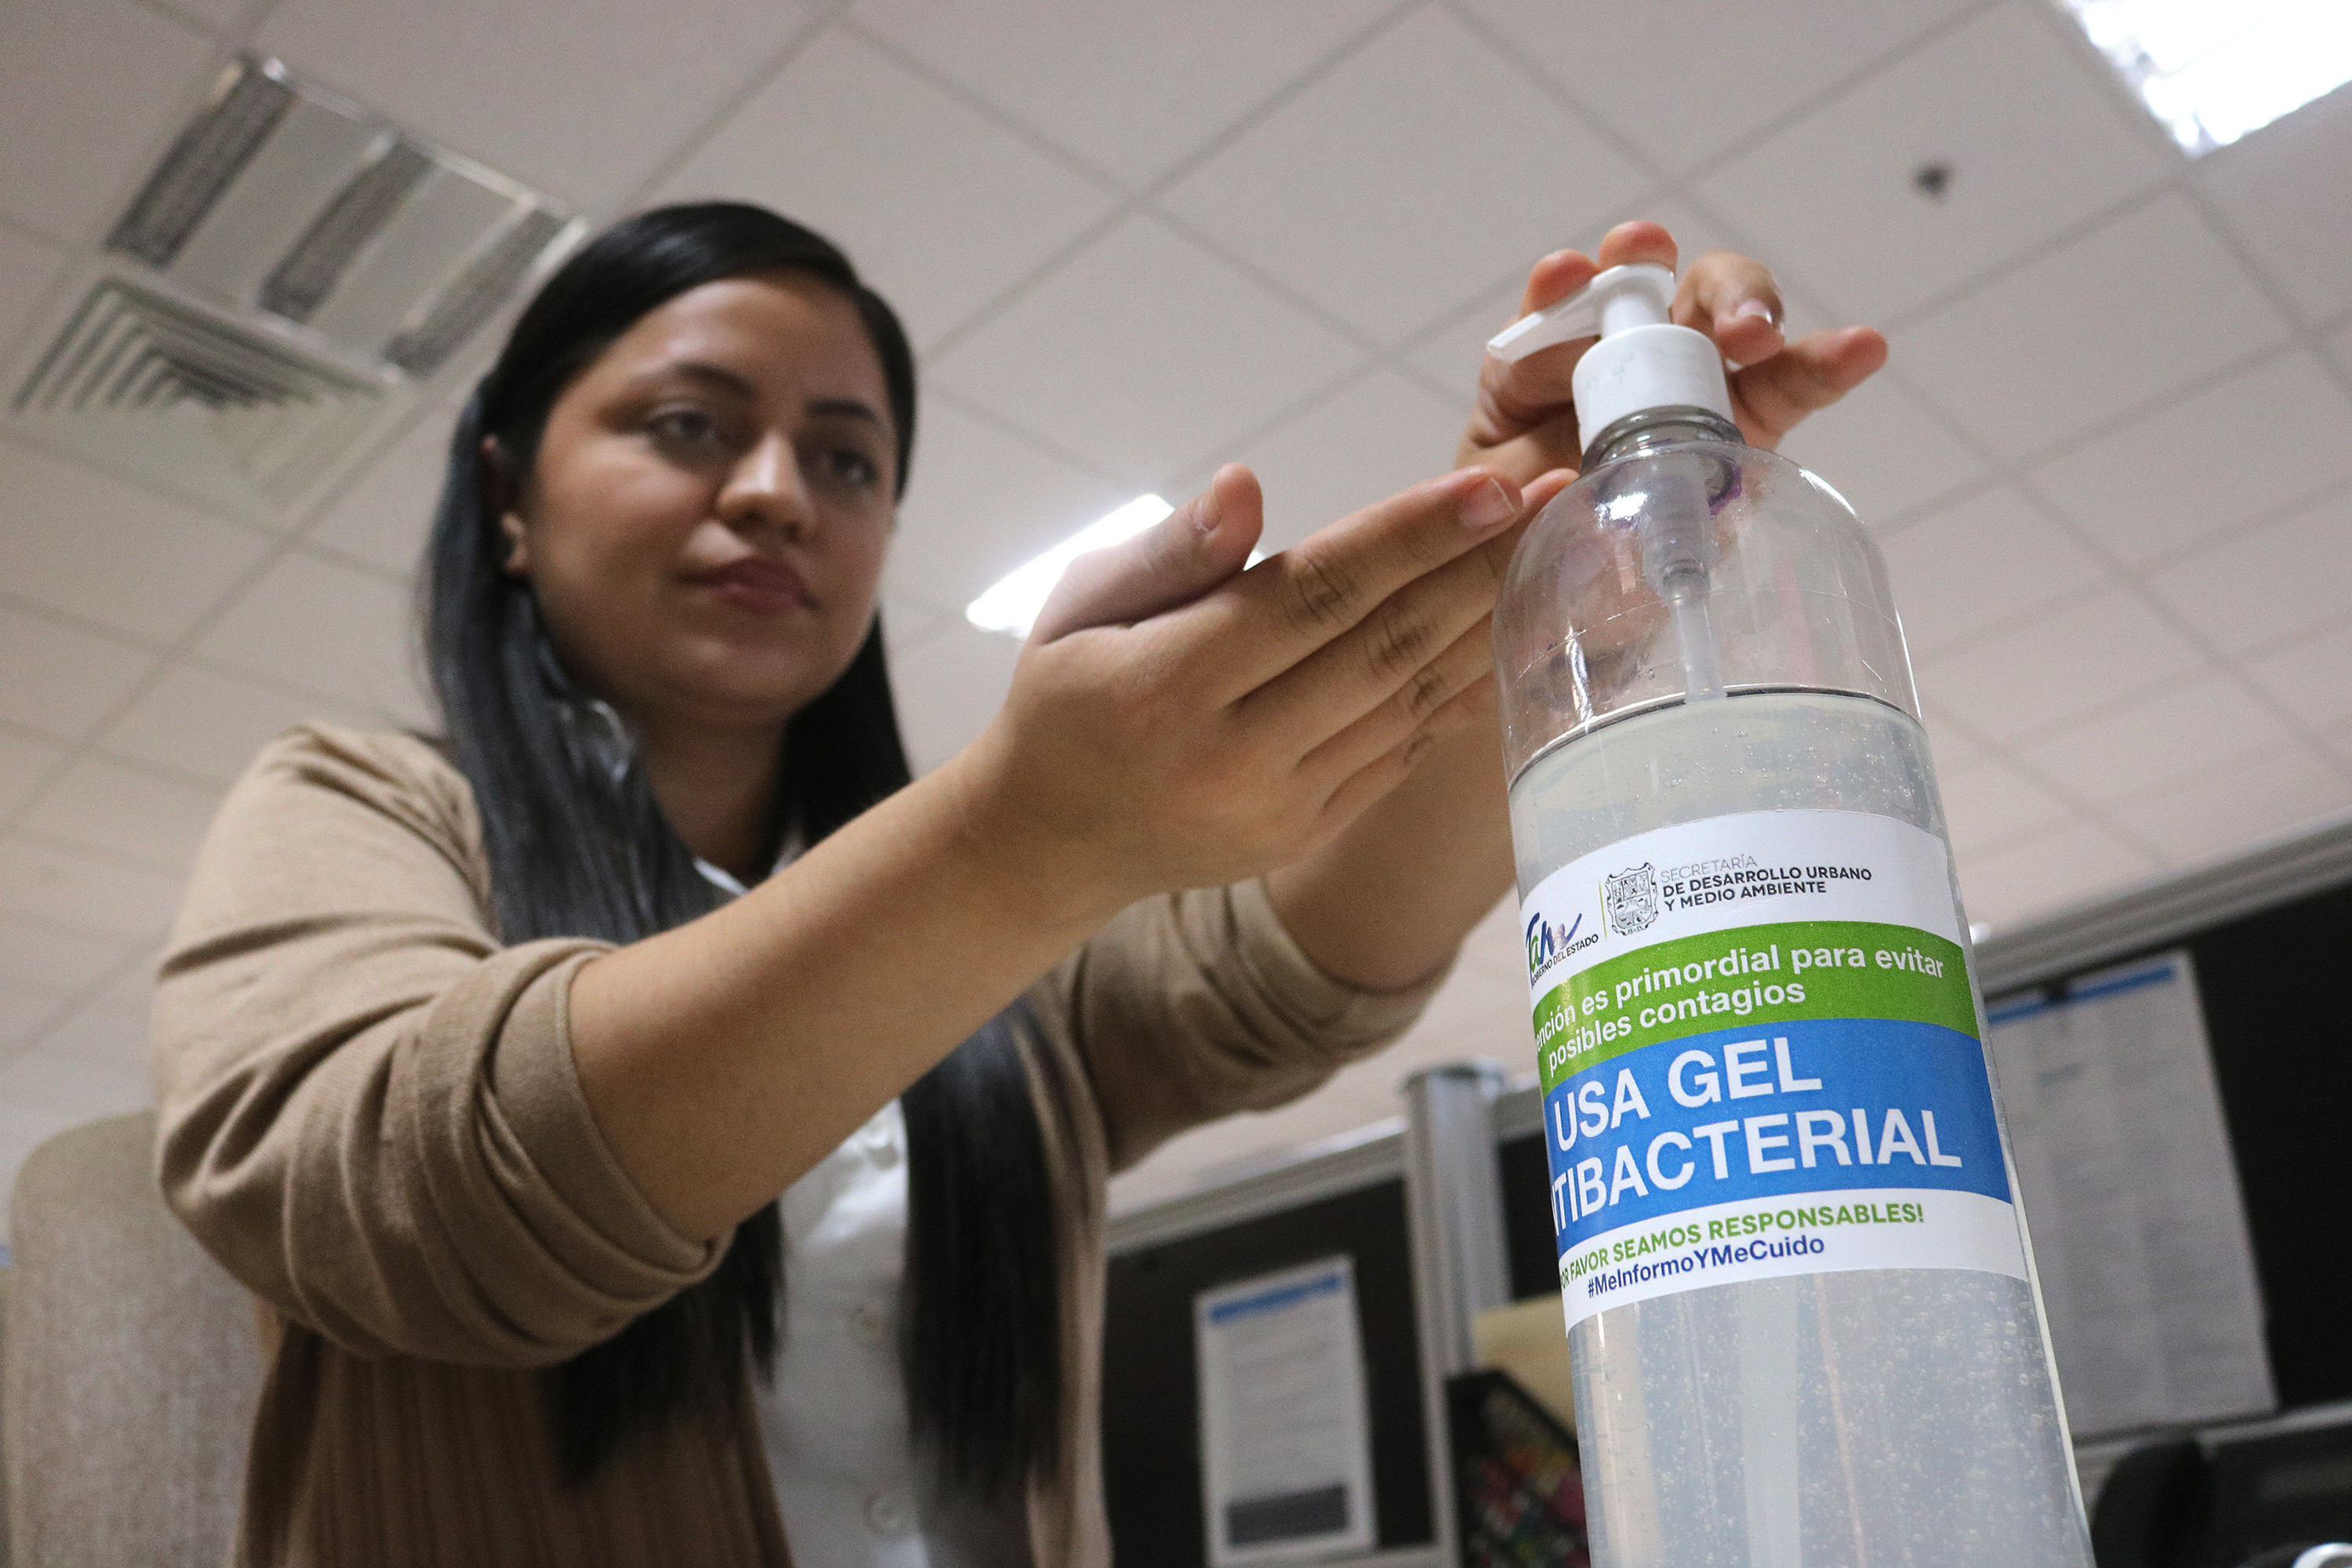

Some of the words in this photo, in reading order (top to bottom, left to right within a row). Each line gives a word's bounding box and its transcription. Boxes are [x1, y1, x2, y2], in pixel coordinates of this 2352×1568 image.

[1661, 854, 1758, 884] SECRETARÍA
[1663, 883, 1685, 898] DE
[1690, 866, 1802, 892] DESARROLLO
[1806, 866, 1872, 881] URBANO
[1664, 899, 1675, 912] Y
[1681, 888, 1735, 909] MEDIO
[1740, 880, 1827, 898] AMBIENTE
[1553, 952, 1566, 966] DEL
[1566, 934, 1599, 957] ESTADO
[1581, 989, 1609, 1016] es
[1615, 944, 1780, 1009] primordial
[1791, 946, 1866, 975] para
[1875, 946, 1944, 978] evitar
[1548, 1015, 1632, 1078] posibles
[1639, 980, 1806, 1028] contagios
[1554, 1068, 1652, 1152] USA
[1668, 1036, 1823, 1108] GEL
[1570, 1247, 1610, 1281] FAVOR
[1613, 1224, 1702, 1262] SEAMOS
[1708, 1203, 1925, 1240] RESPONSABLES!
[1588, 1235, 1825, 1298] #MeInformoYMeCuido
